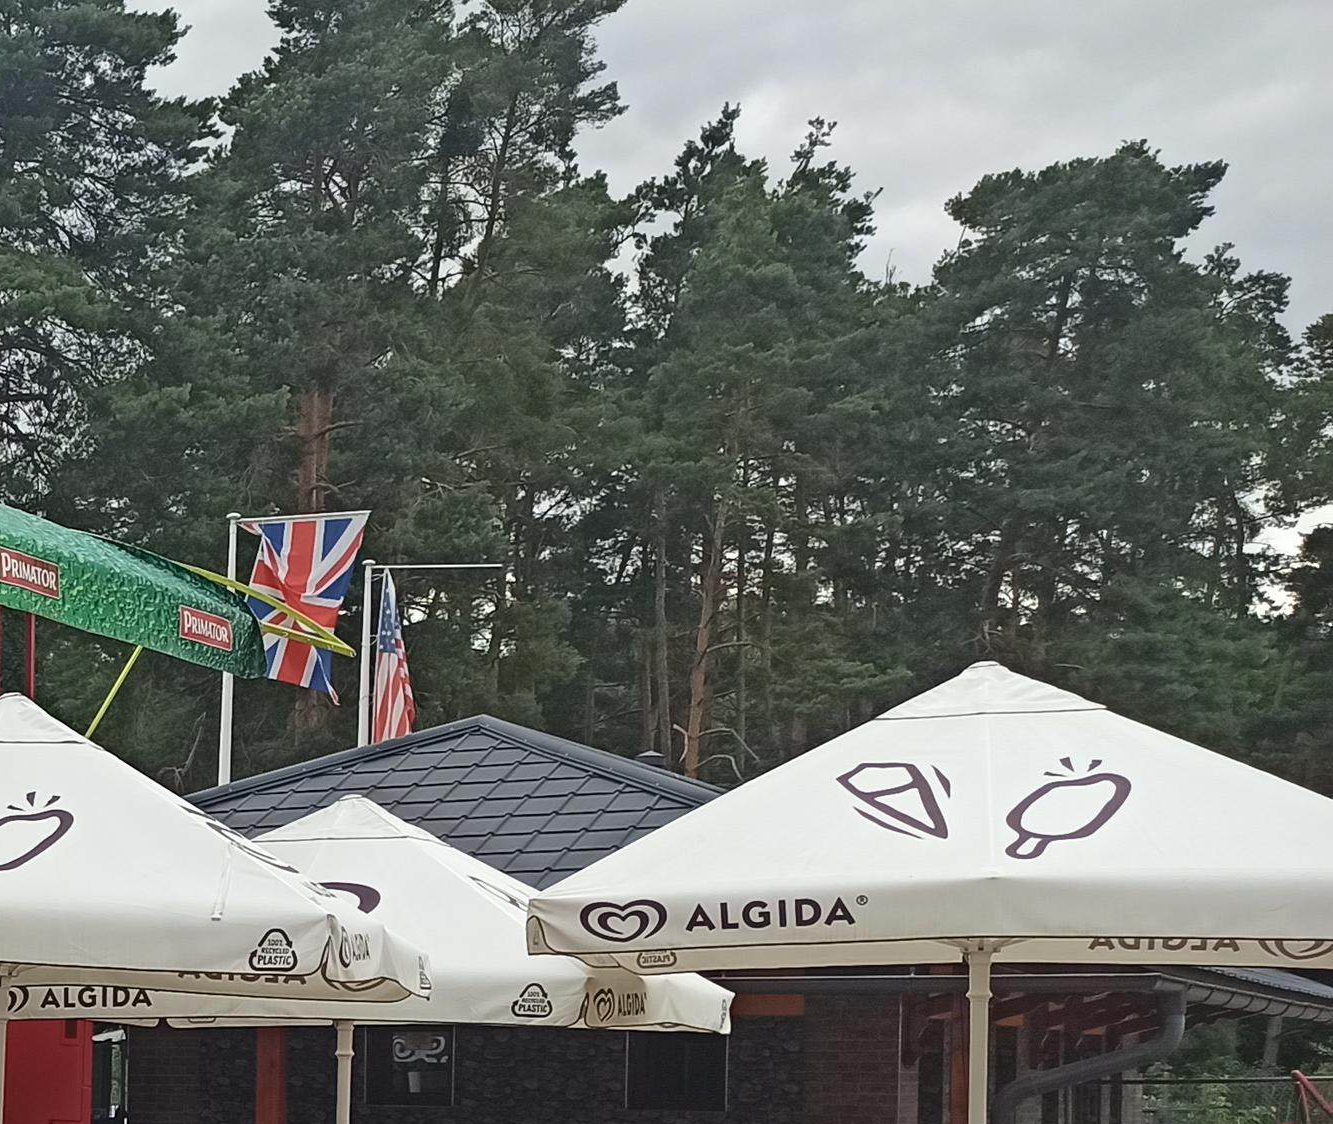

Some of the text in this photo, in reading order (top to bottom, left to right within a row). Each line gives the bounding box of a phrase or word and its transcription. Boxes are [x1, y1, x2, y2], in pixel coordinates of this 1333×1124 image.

[0, 553, 58, 591] PRIMATOR
[183, 612, 230, 644] PRIMATOR
[256, 954, 293, 966] PLASTIC
[40, 985, 153, 1009] ALGIDA
[517, 1004, 548, 1014] PLASTIC
